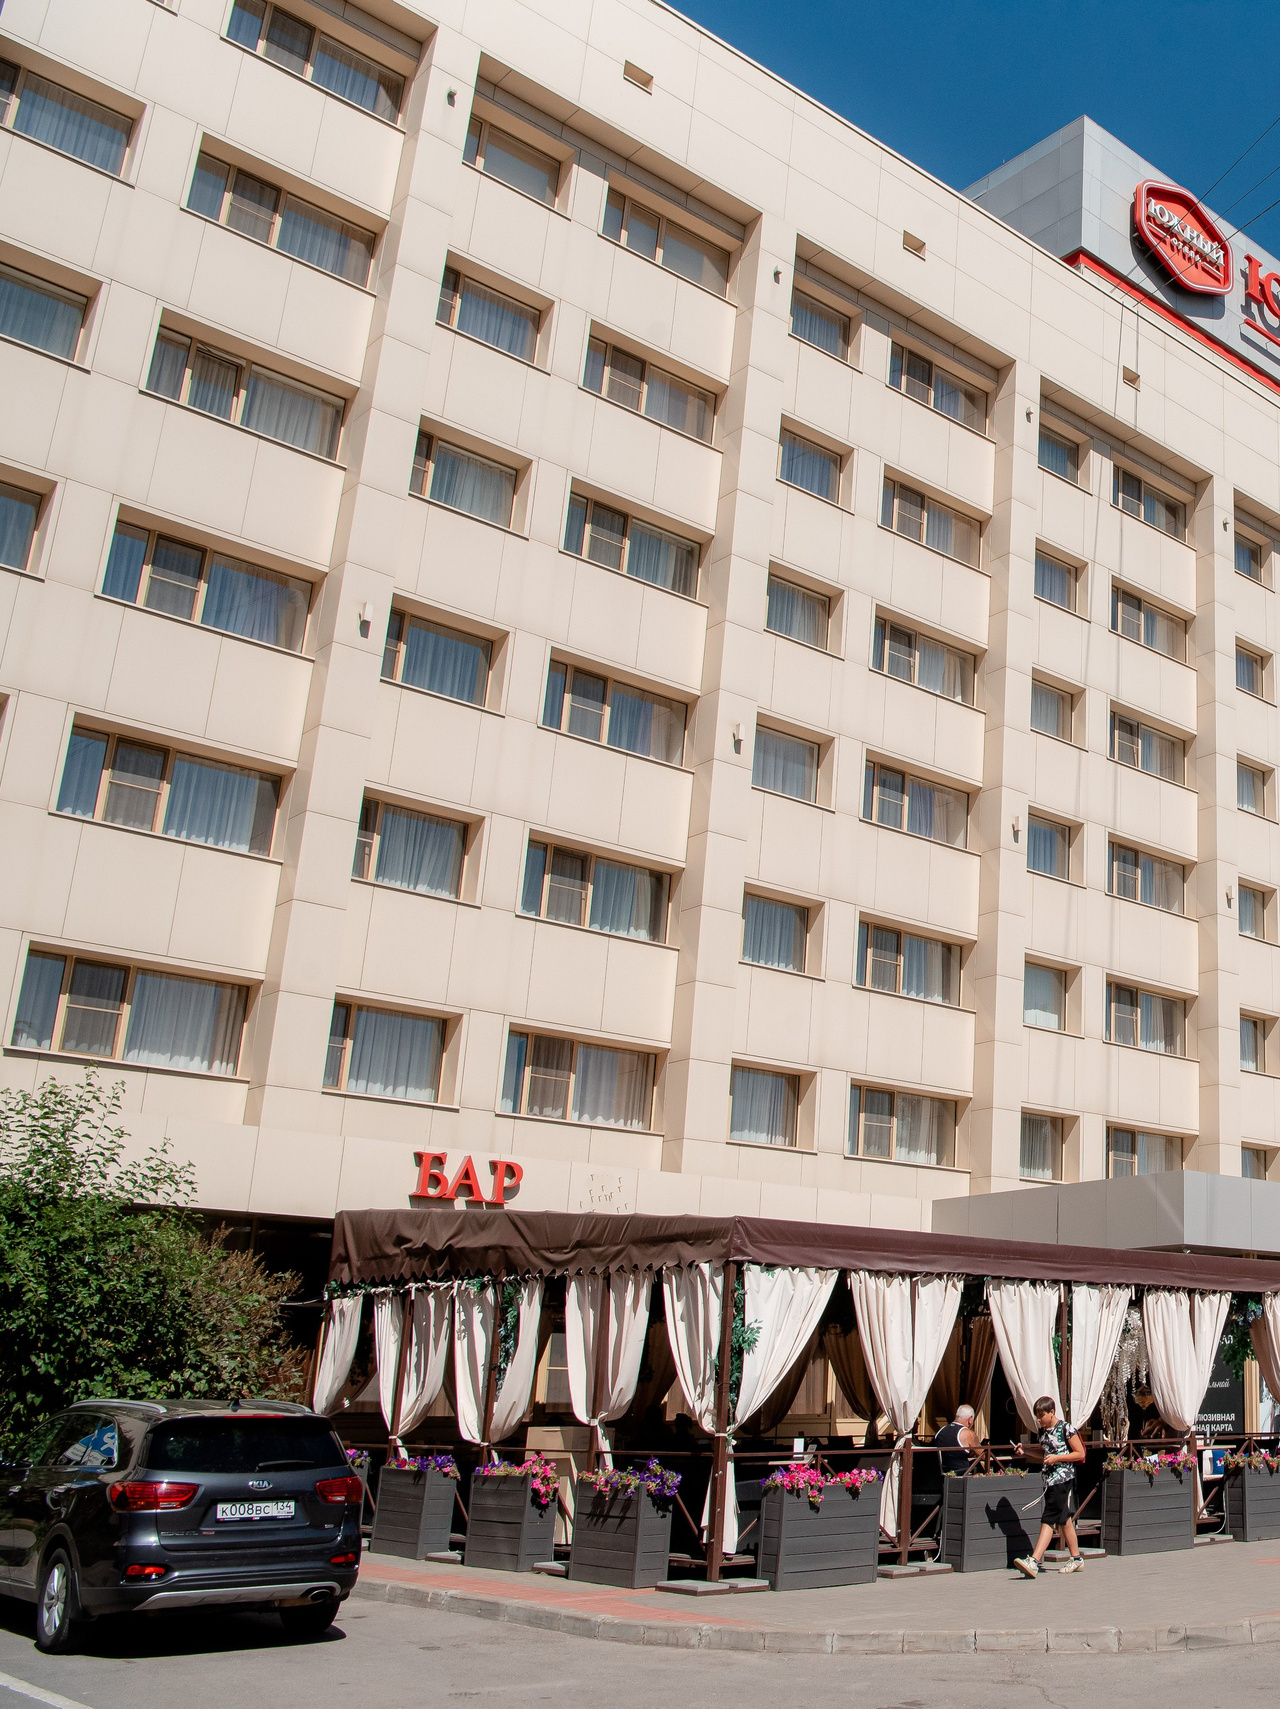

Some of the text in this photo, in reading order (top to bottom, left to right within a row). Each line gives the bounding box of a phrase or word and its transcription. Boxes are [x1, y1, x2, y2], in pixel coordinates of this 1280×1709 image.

[1146, 197, 1225, 266] ЮЖНЫЙ
[1170, 237, 1202, 263] ОТЕЛЬ
[408, 1151, 523, 1204] БАР
[1196, 1413, 1235, 1421] ЛЮЗИВНАЯ
[1211, 1424, 1233, 1432] КАРТА
[252, 1480, 270, 1489] KIA
[273, 1501, 292, 1511] 134
